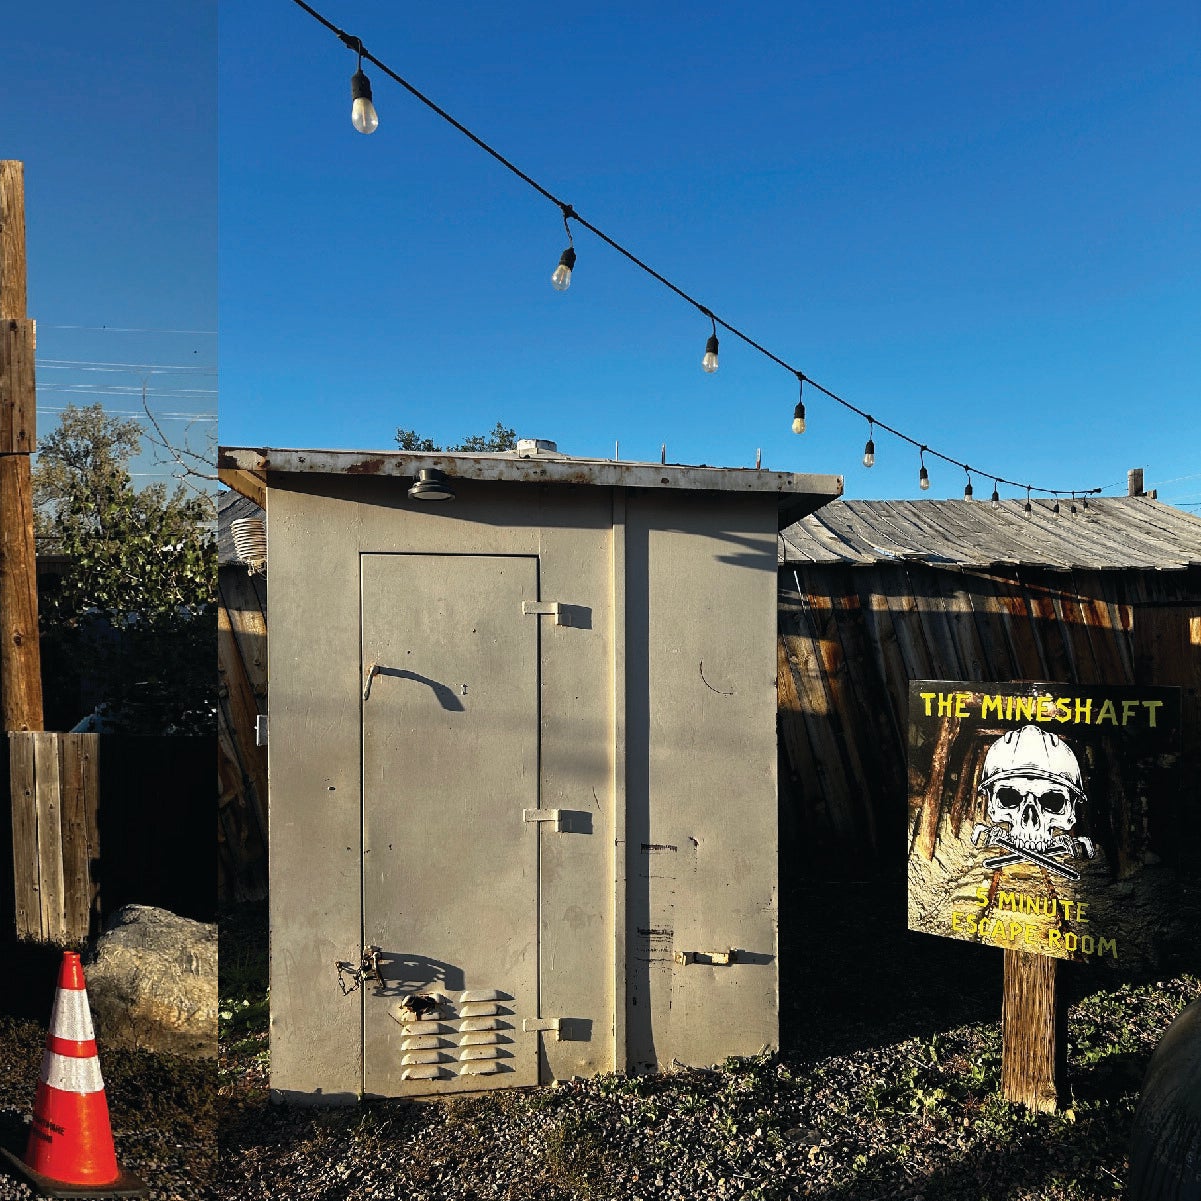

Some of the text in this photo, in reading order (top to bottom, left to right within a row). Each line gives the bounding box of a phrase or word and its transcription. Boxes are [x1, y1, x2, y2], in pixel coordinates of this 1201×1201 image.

[919, 692, 1164, 728] THE MINESHAFT
[975, 887, 1091, 923] 5 MINUTE
[951, 911, 1119, 959] ESCAPE ROOM
